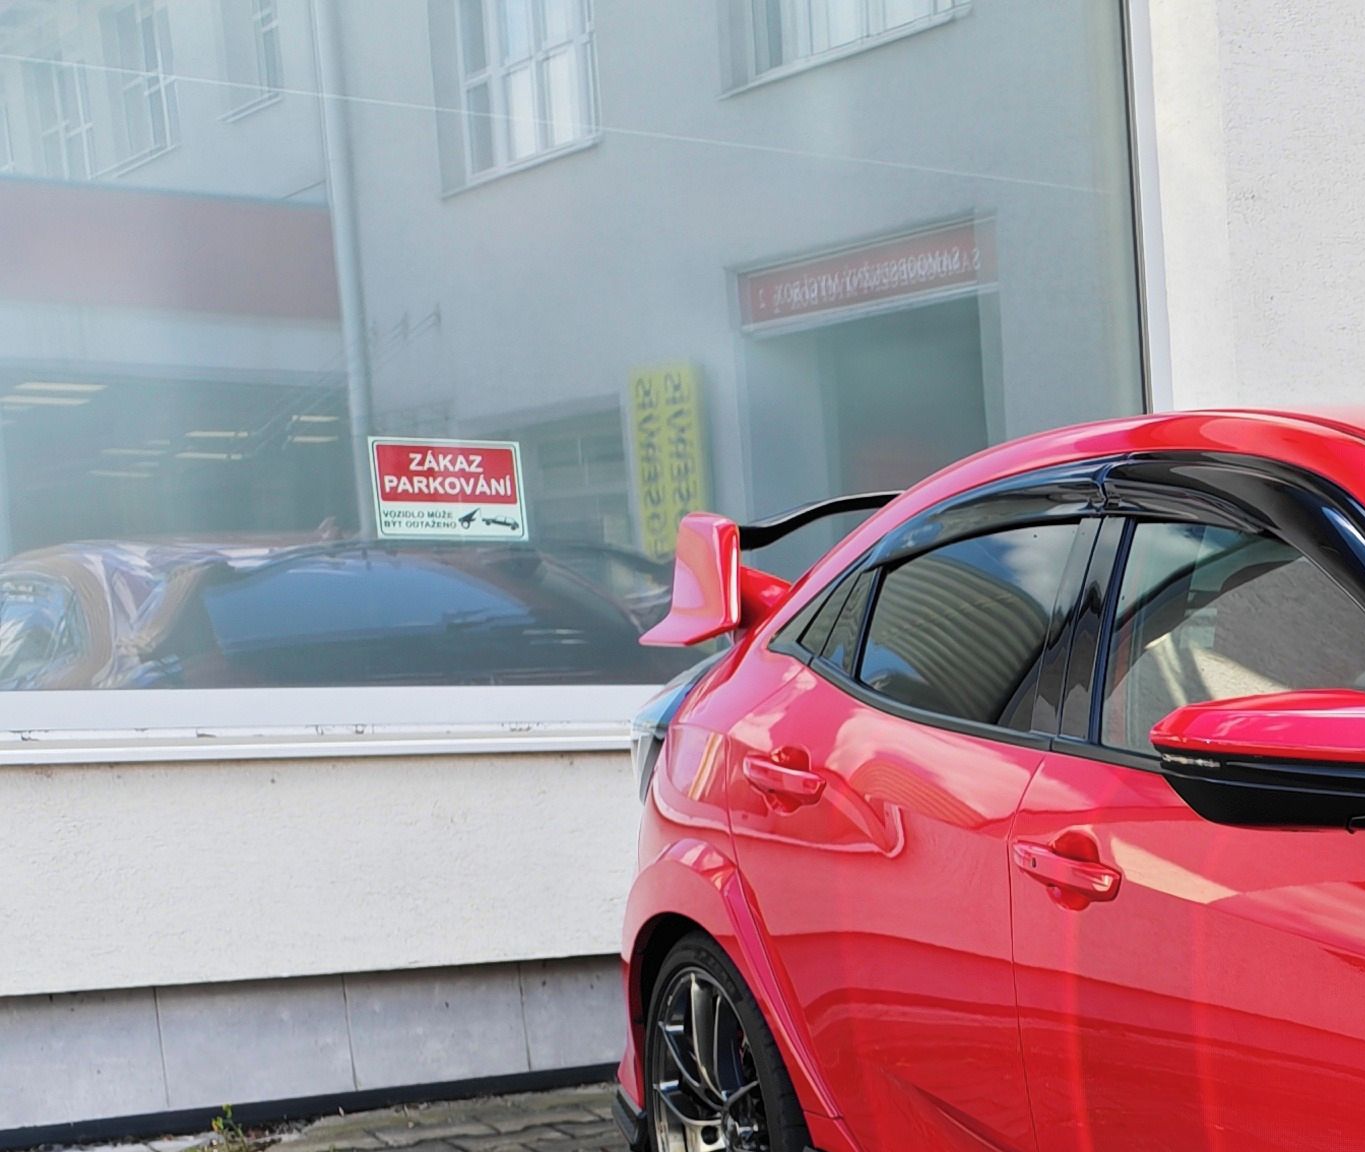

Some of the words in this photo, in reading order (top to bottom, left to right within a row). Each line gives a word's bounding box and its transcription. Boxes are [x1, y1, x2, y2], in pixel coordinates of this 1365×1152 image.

[408, 450, 484, 473] ZÁKAZ
[383, 475, 511, 496] PARKOVÁNÍ
[382, 510, 425, 519] VOZIDLO
[427, 509, 453, 519] MŮŽE
[384, 519, 402, 528] BÝT
